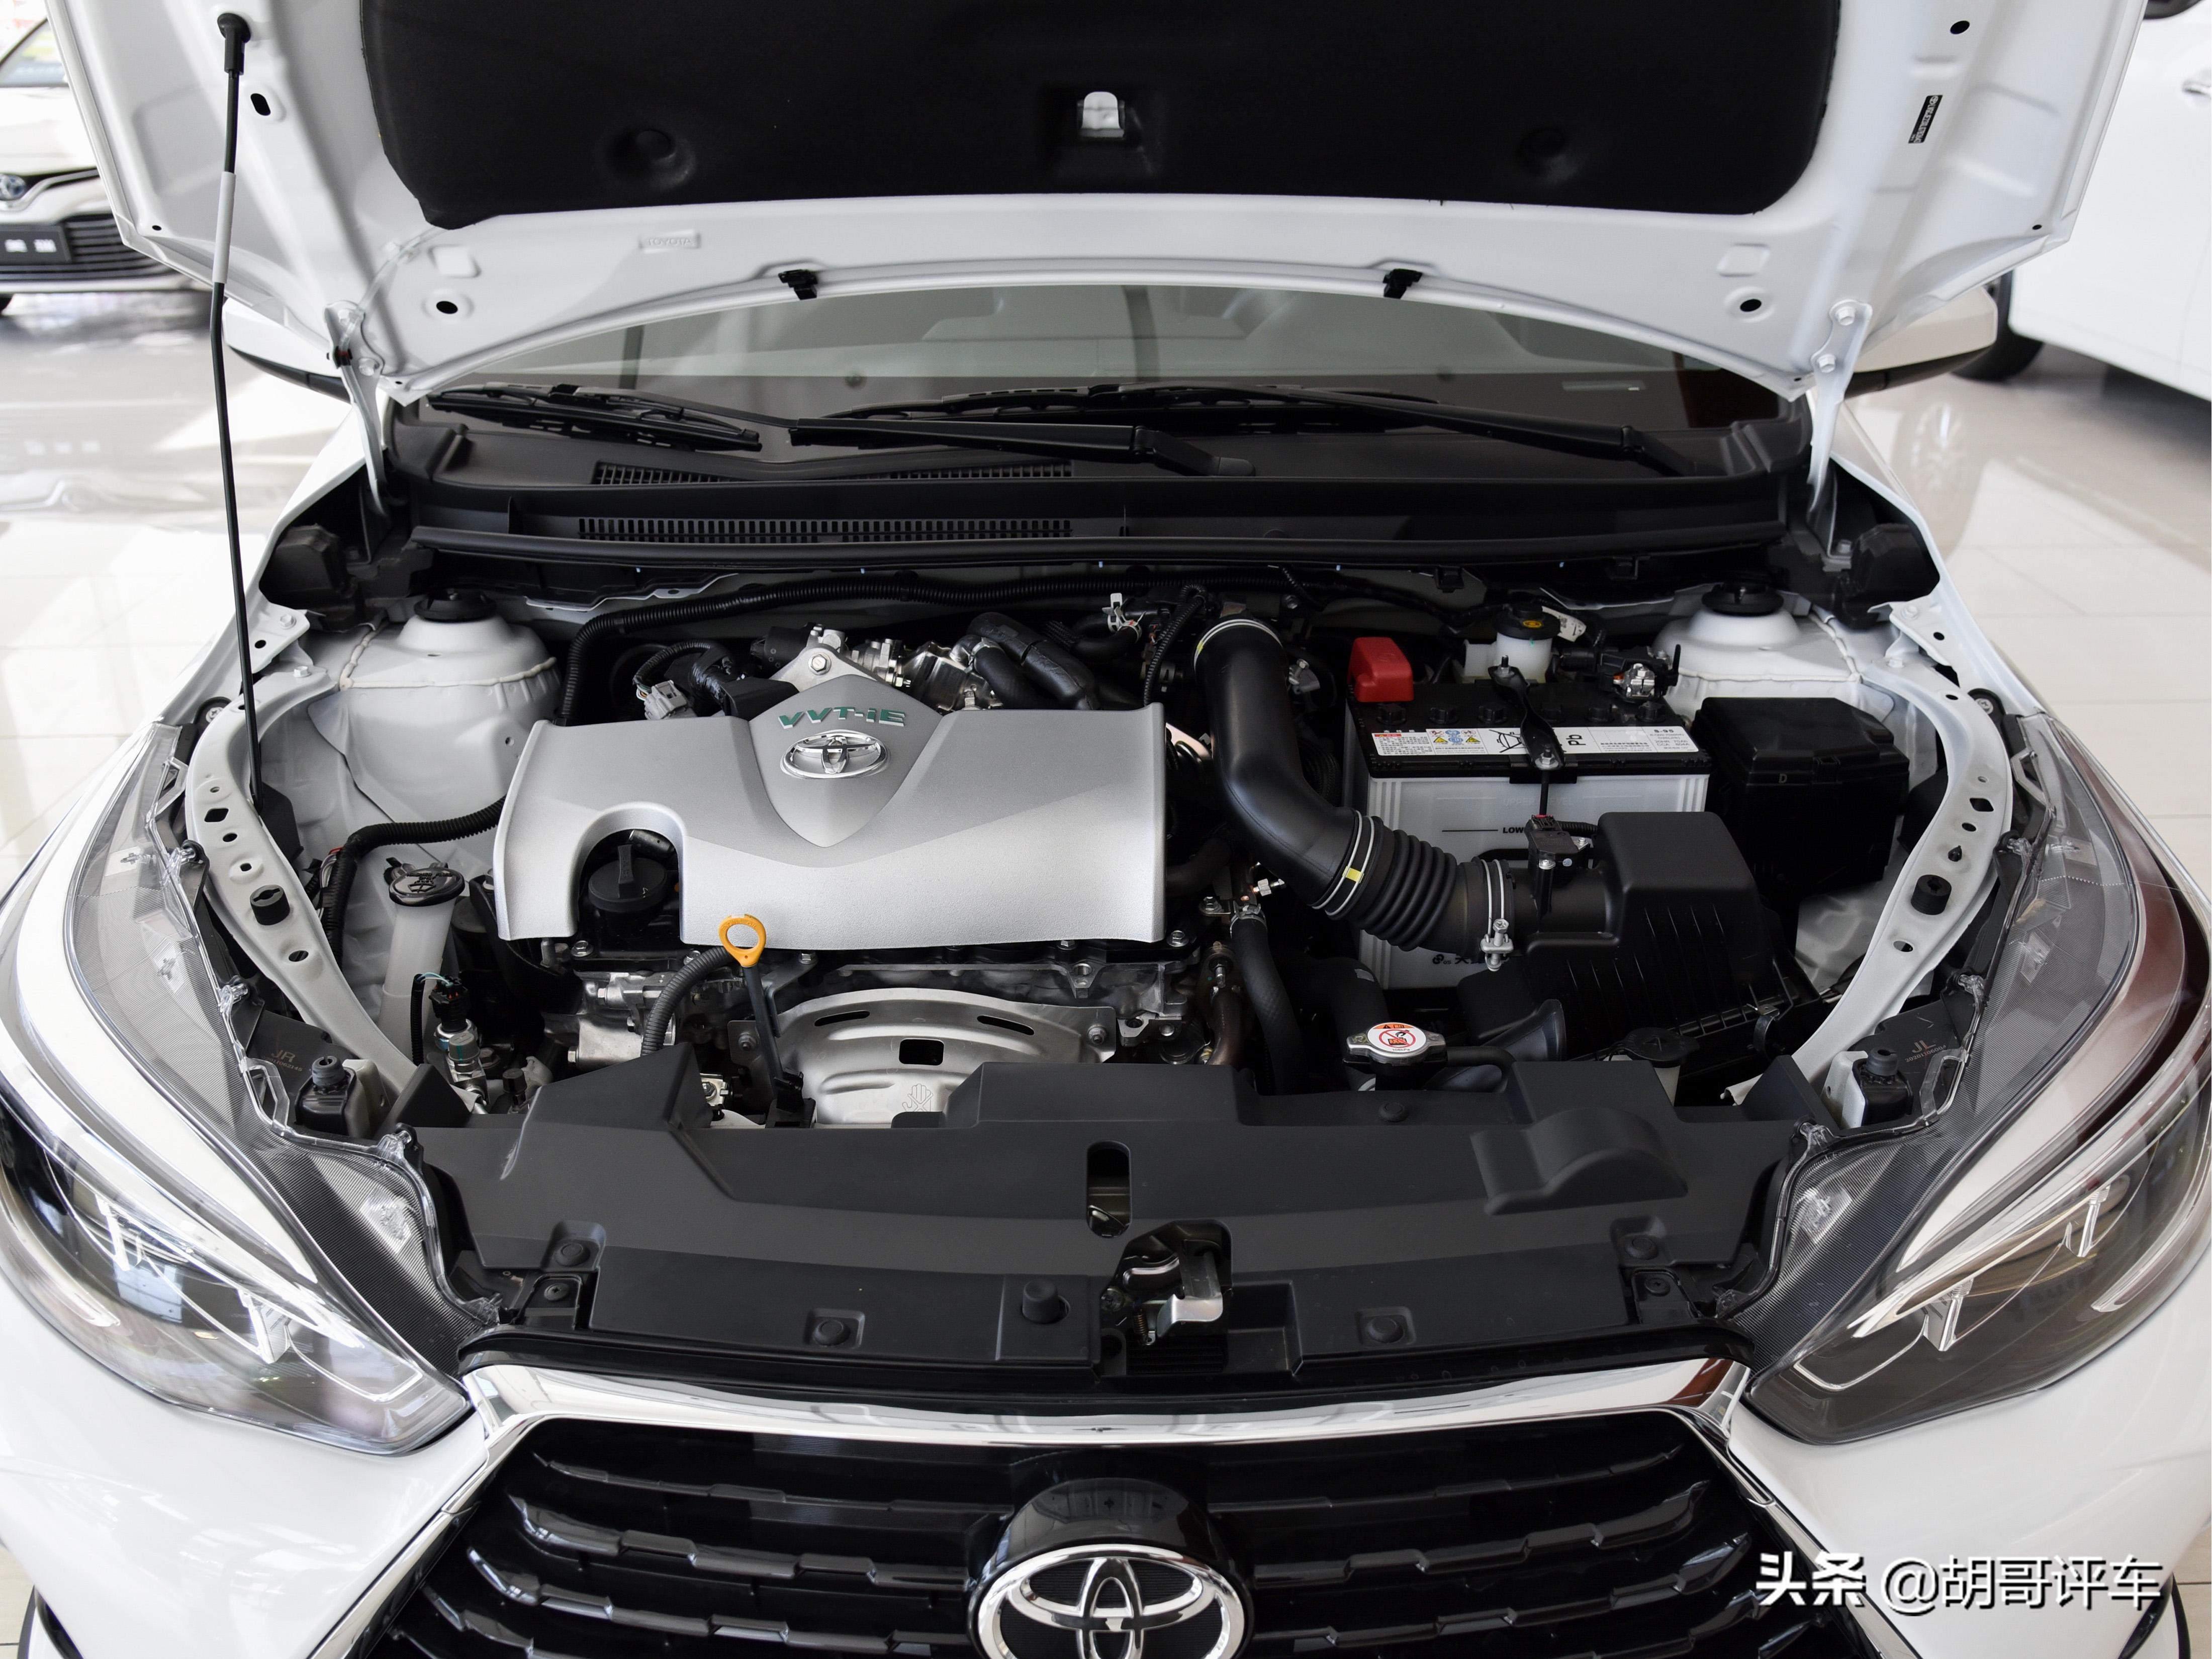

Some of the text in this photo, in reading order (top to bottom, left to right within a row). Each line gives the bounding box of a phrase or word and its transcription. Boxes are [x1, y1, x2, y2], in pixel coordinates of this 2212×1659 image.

[648, 237, 695, 246] TOYOTA
[1565, 734, 1586, 746] Pb
[1911, 1040, 1936, 1053] JL
[270, 1050, 296, 1063] JR
